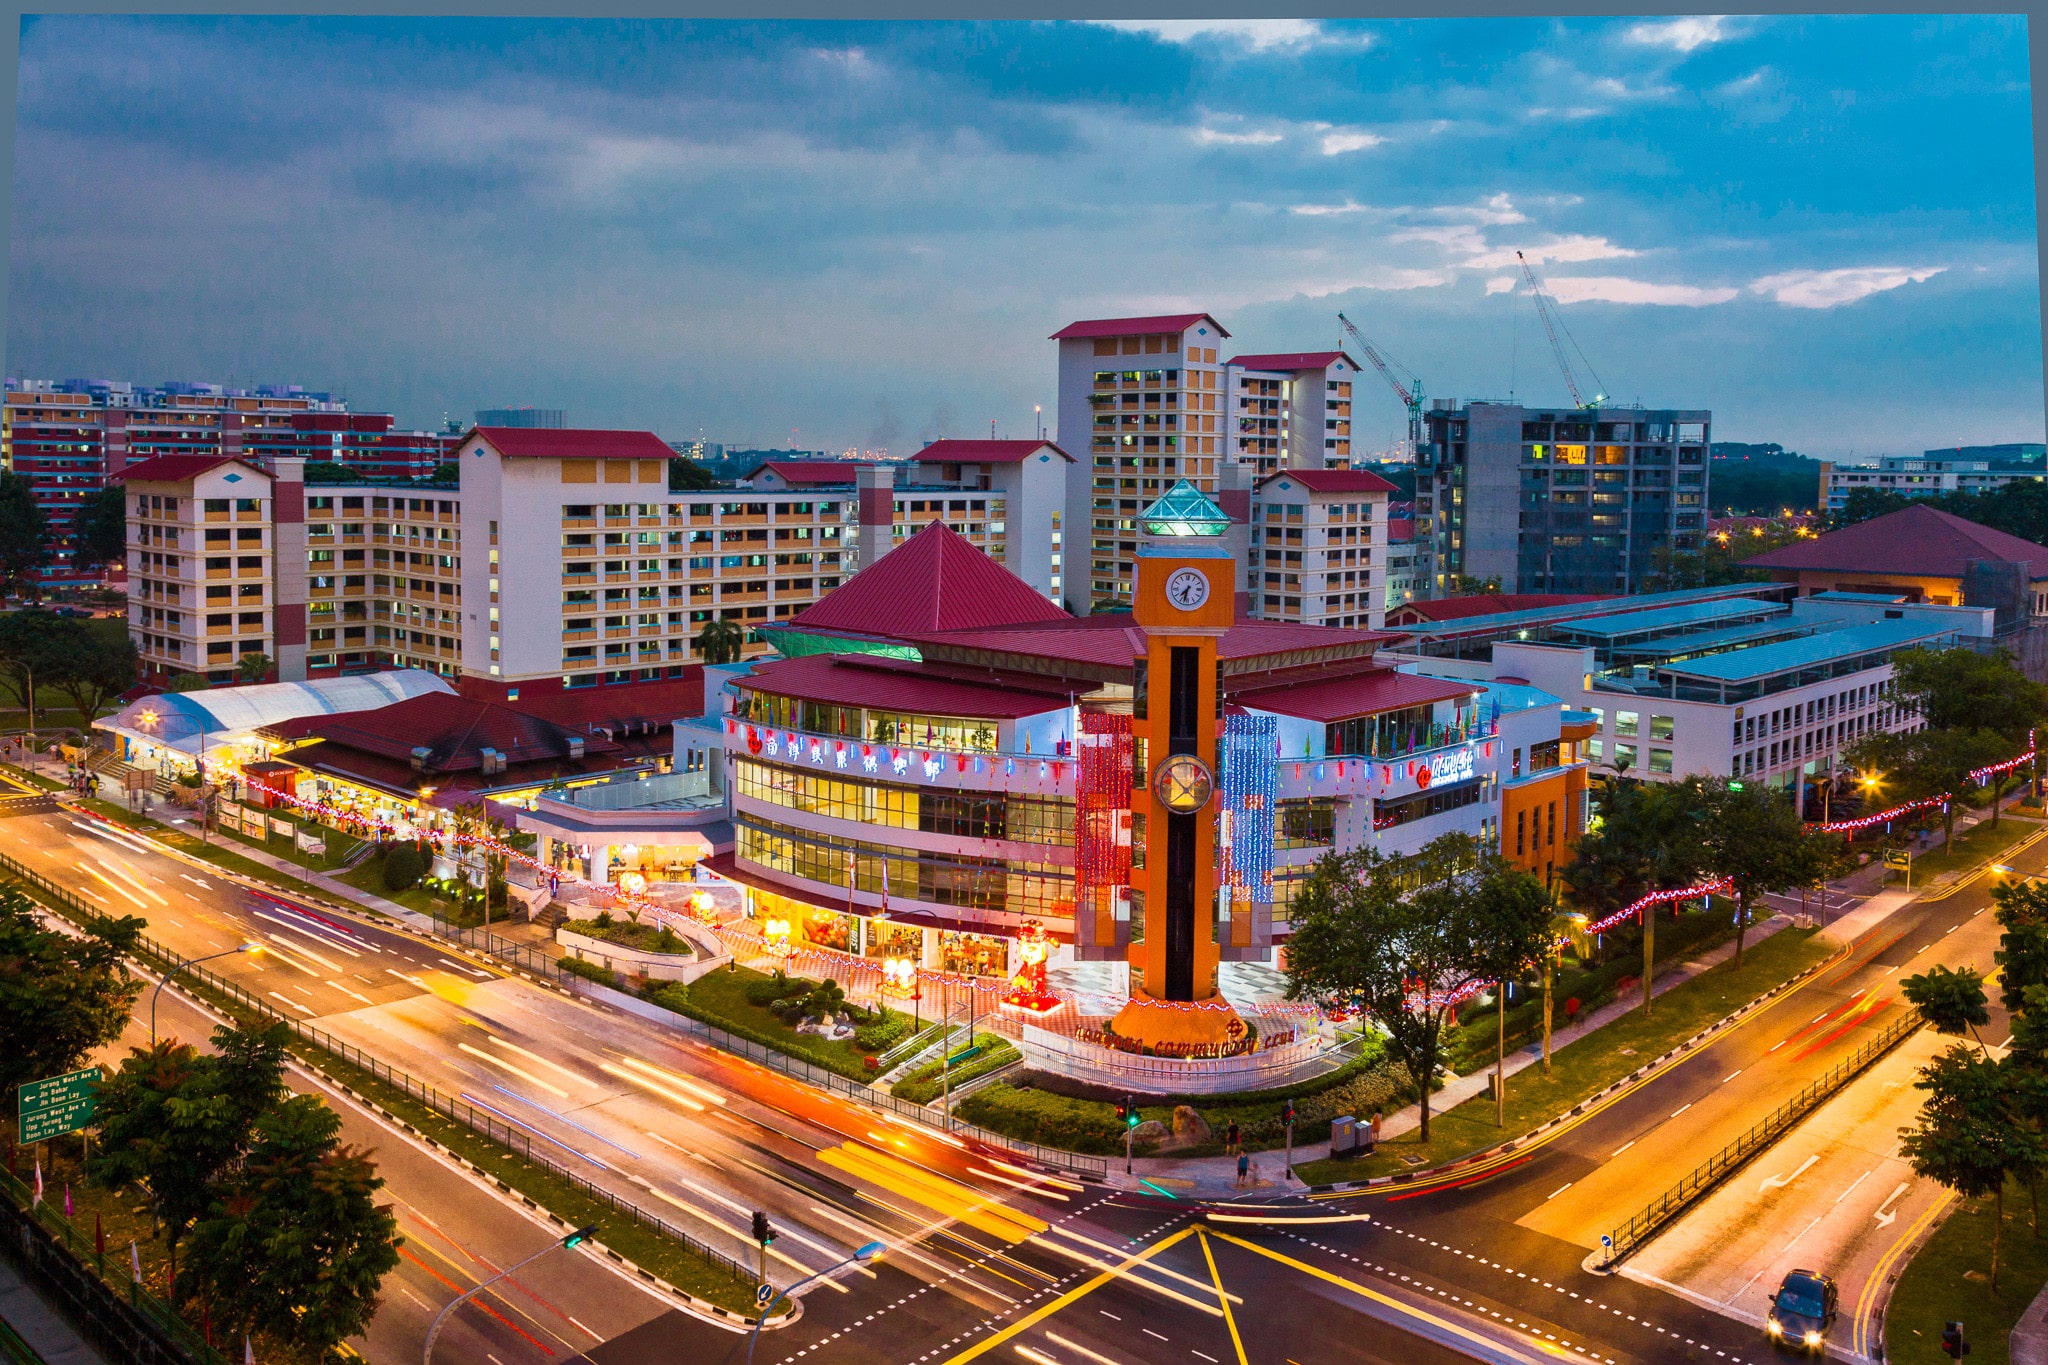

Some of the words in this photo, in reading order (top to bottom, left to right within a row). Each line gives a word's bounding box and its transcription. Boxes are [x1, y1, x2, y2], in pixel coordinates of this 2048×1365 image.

[39, 1081, 60, 1090] Jurong
[63, 1075, 78, 1083] West
[51, 1086, 68, 1095] Bahar
[51, 1095, 66, 1104] Boon
[68, 1091, 80, 1099] Lay
[26, 1113, 47, 1123] Jurong
[50, 1107, 65, 1116] West
[41, 1118, 62, 1127] Jurong
[64, 1113, 73, 1121] Rd
[26, 1131, 41, 1140] Boon
[58, 1123, 71, 1131] Way
